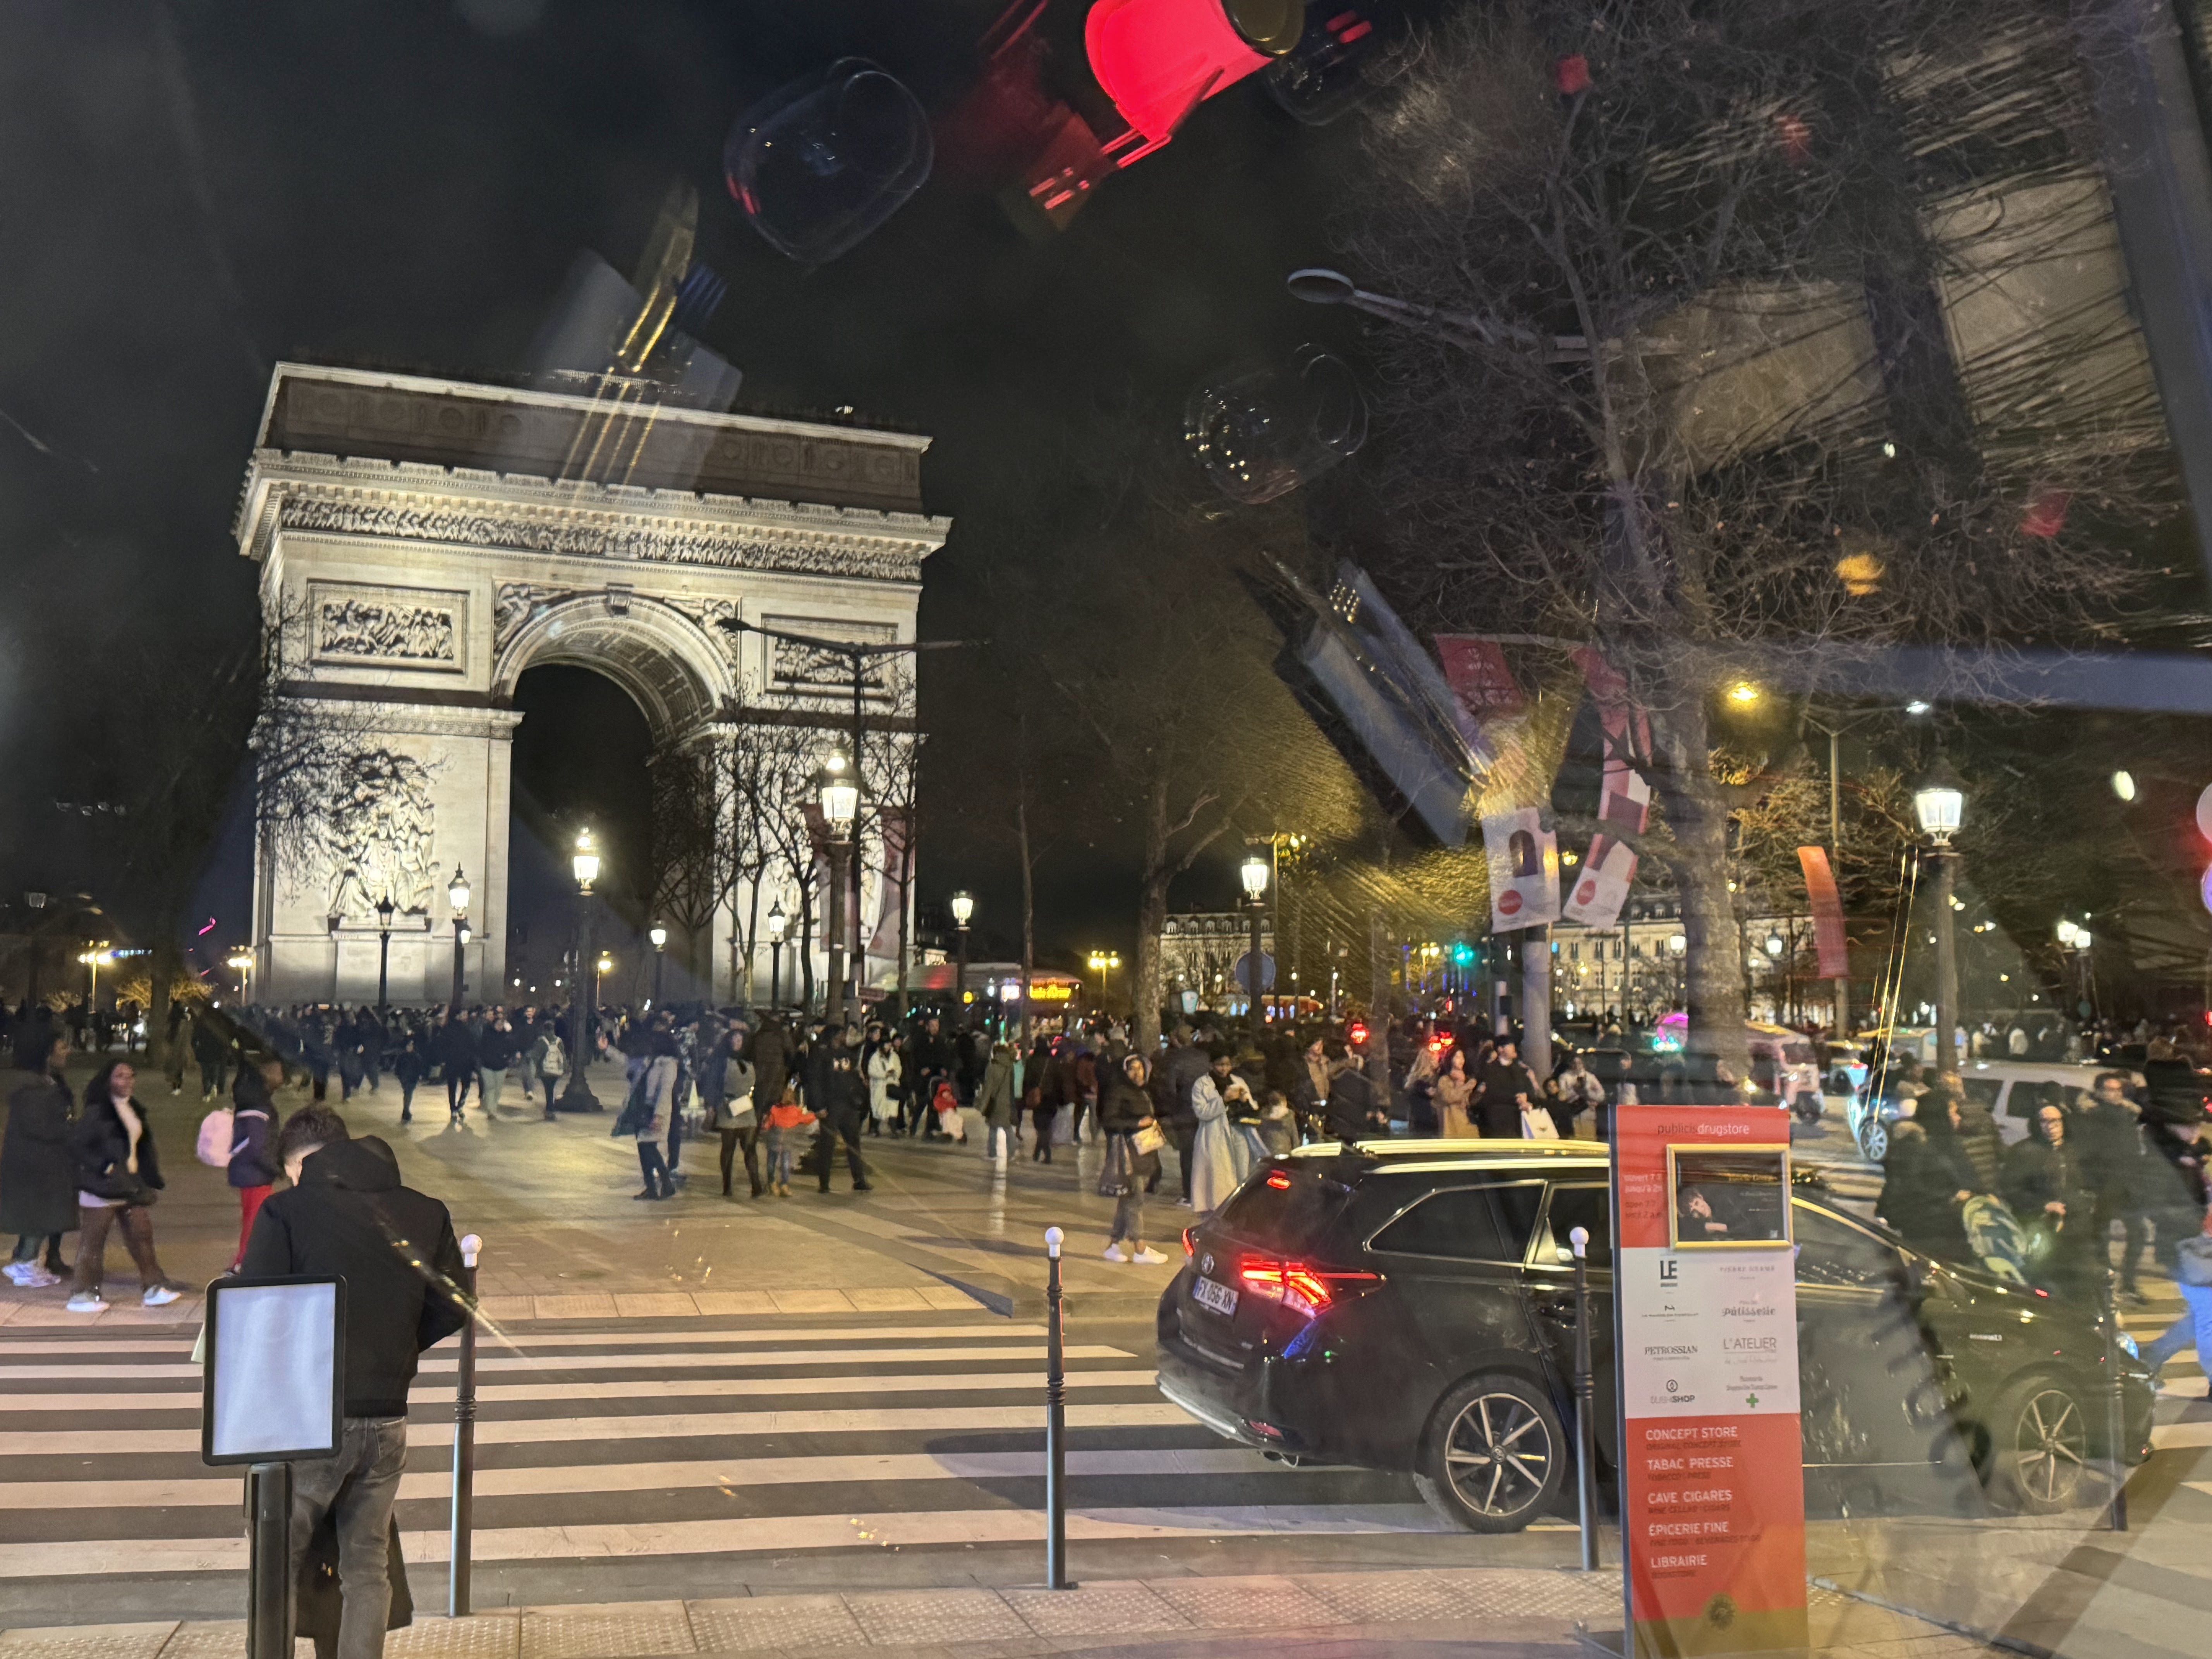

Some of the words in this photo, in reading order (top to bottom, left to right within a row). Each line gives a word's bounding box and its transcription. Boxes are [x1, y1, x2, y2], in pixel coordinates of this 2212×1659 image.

[1660, 1260, 1678, 1280] LE
[1645, 1346, 1698, 1355] PETROSSIAN
[1646, 1428, 1698, 1440] CONCEPT
[1701, 1426, 1738, 1438] STORE
[1647, 1458, 1684, 1471] TABAC
[1689, 1456, 1734, 1468] PRESSE
[1648, 1492, 1678, 1504] CAVE
[1683, 1490, 1733, 1503] CIGARES
[1649, 1523, 1700, 1537] ÉPICERIE
[1704, 1521, 1729, 1533] FINE
[1650, 1554, 1707, 1568] LIBRAIRIE
